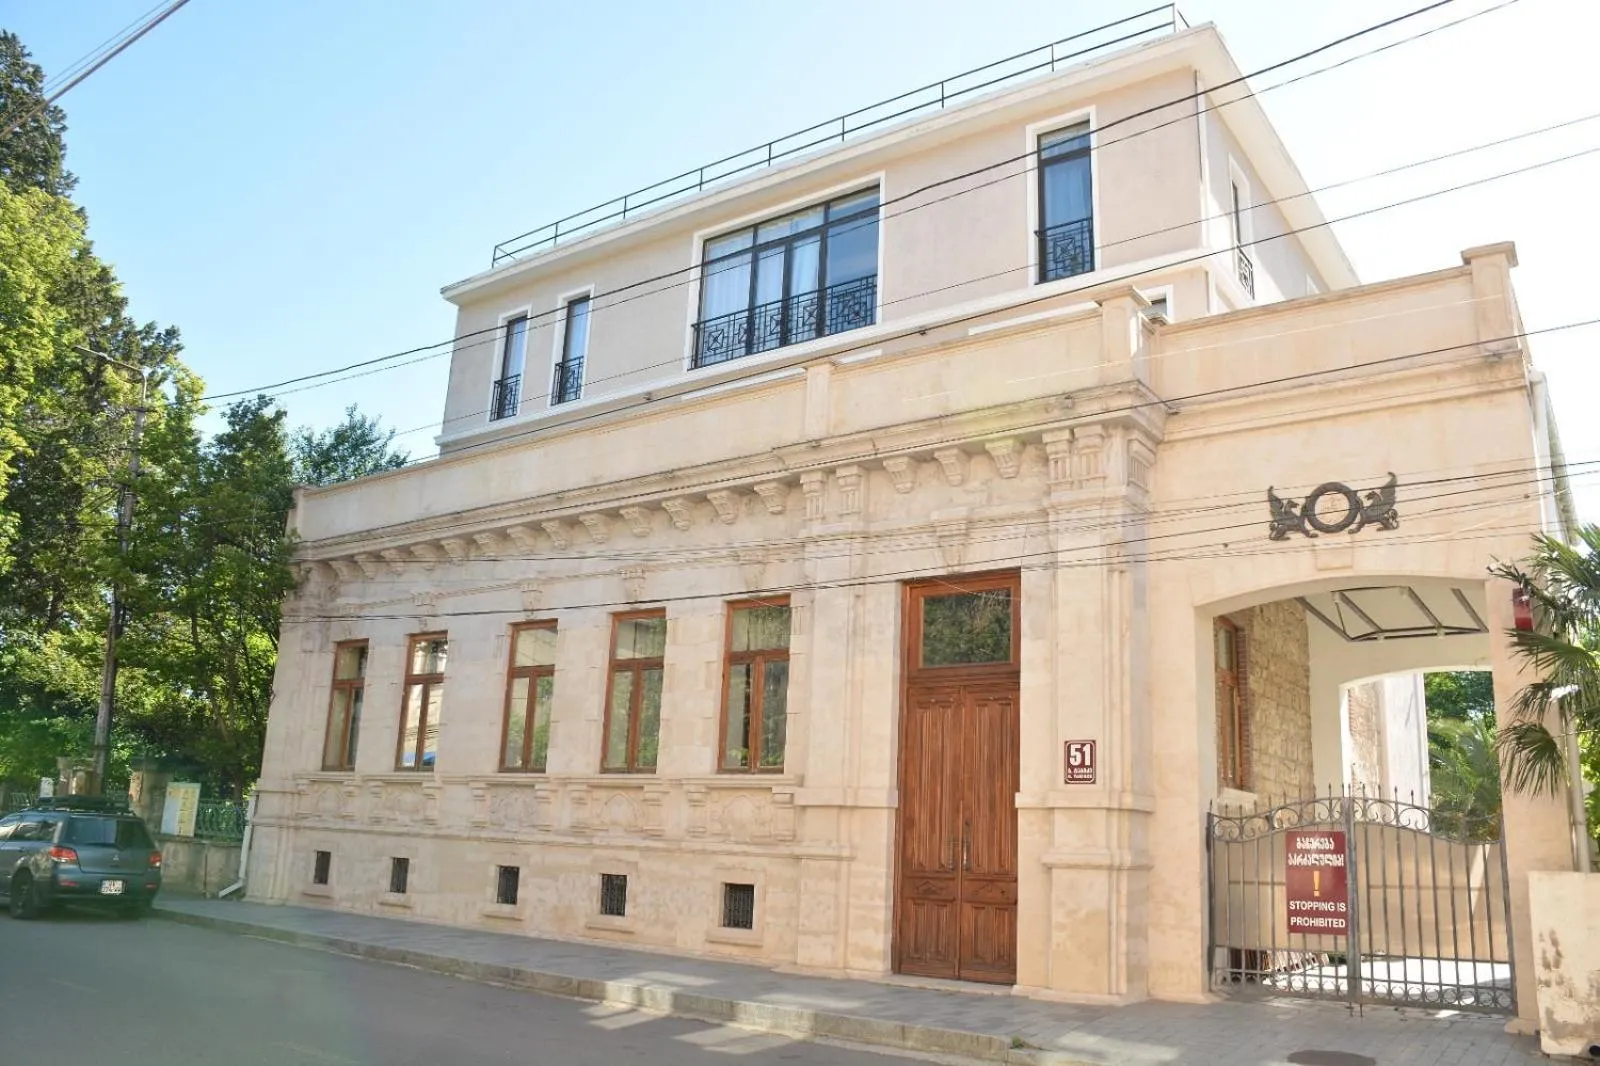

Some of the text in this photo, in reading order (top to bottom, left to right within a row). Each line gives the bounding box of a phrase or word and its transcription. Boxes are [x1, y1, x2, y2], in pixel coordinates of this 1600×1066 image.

[1070, 743, 1091, 766] 51
[1289, 901, 1346, 912] STOPPING IS
[1290, 917, 1346, 928] PROHIBITED
